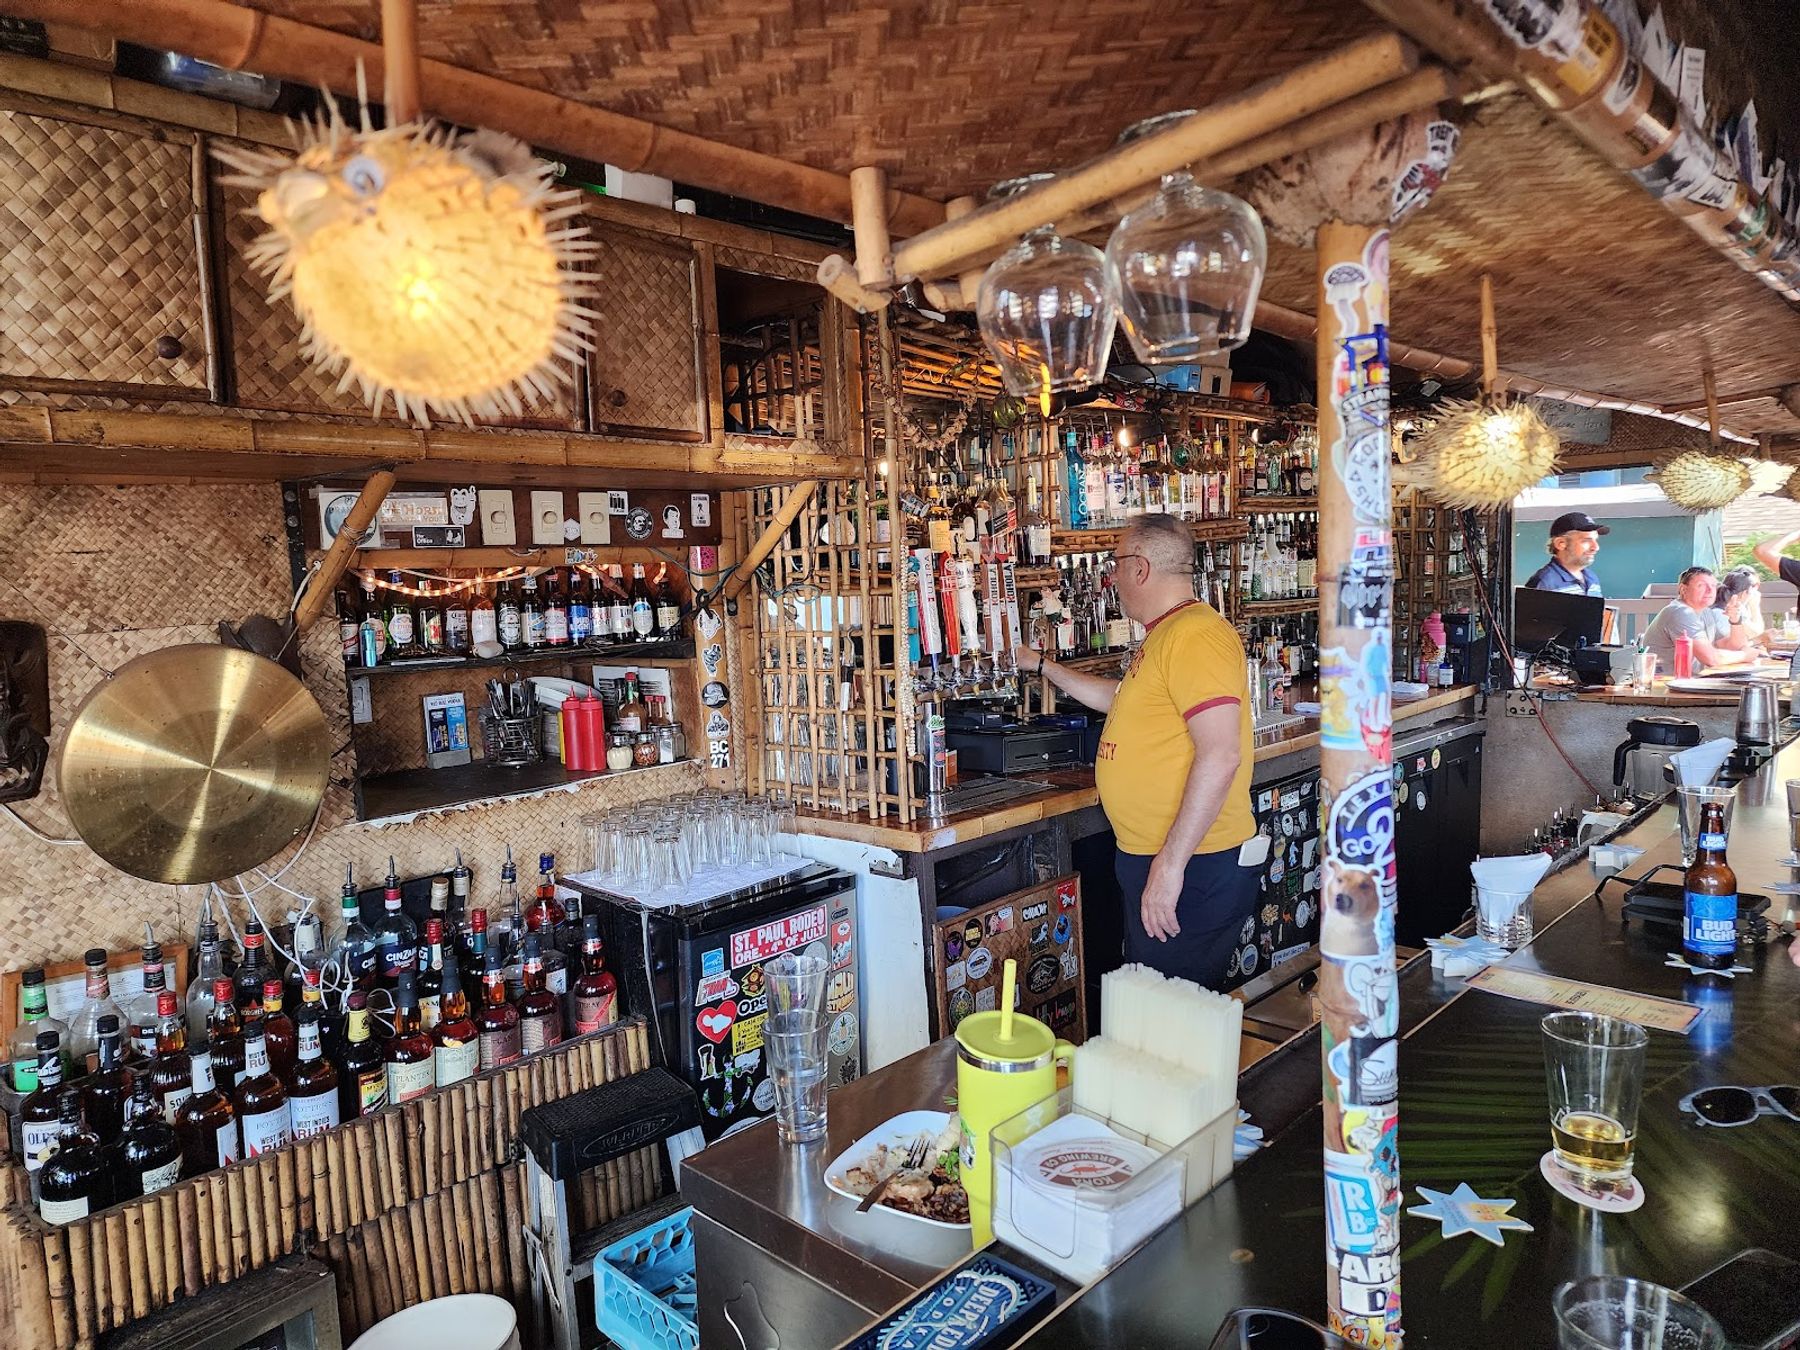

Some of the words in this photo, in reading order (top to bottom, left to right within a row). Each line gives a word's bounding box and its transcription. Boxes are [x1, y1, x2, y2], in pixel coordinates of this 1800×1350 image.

[1078, 469, 1088, 516] OCEAN
[988, 567, 999, 606] KOHOLA
[1003, 564, 1016, 604] KOHOLA
[710, 740, 729, 754] BC
[710, 753, 730, 769] 271
[734, 932, 754, 953] ST.
[756, 921, 788, 946] PAUL
[788, 908, 825, 936] RODEO
[1702, 919, 1734, 931] BUD
[1695, 928, 1737, 942] LIGHT
[735, 947, 763, 965] ORE.
[785, 934, 799, 948] OF
[800, 923, 825, 943] JULY
[299, 1040, 321, 1052] RUM
[296, 1119, 311, 1129] WEST
[311, 1115, 330, 1127] INDIES
[297, 1124, 331, 1140] RUM
[260, 1134, 277, 1146] WEST
[1058, 1152, 1117, 1164] BREWING
[1071, 1175, 1115, 1187] KONA
[958, 1284, 1000, 1319] DEEP
